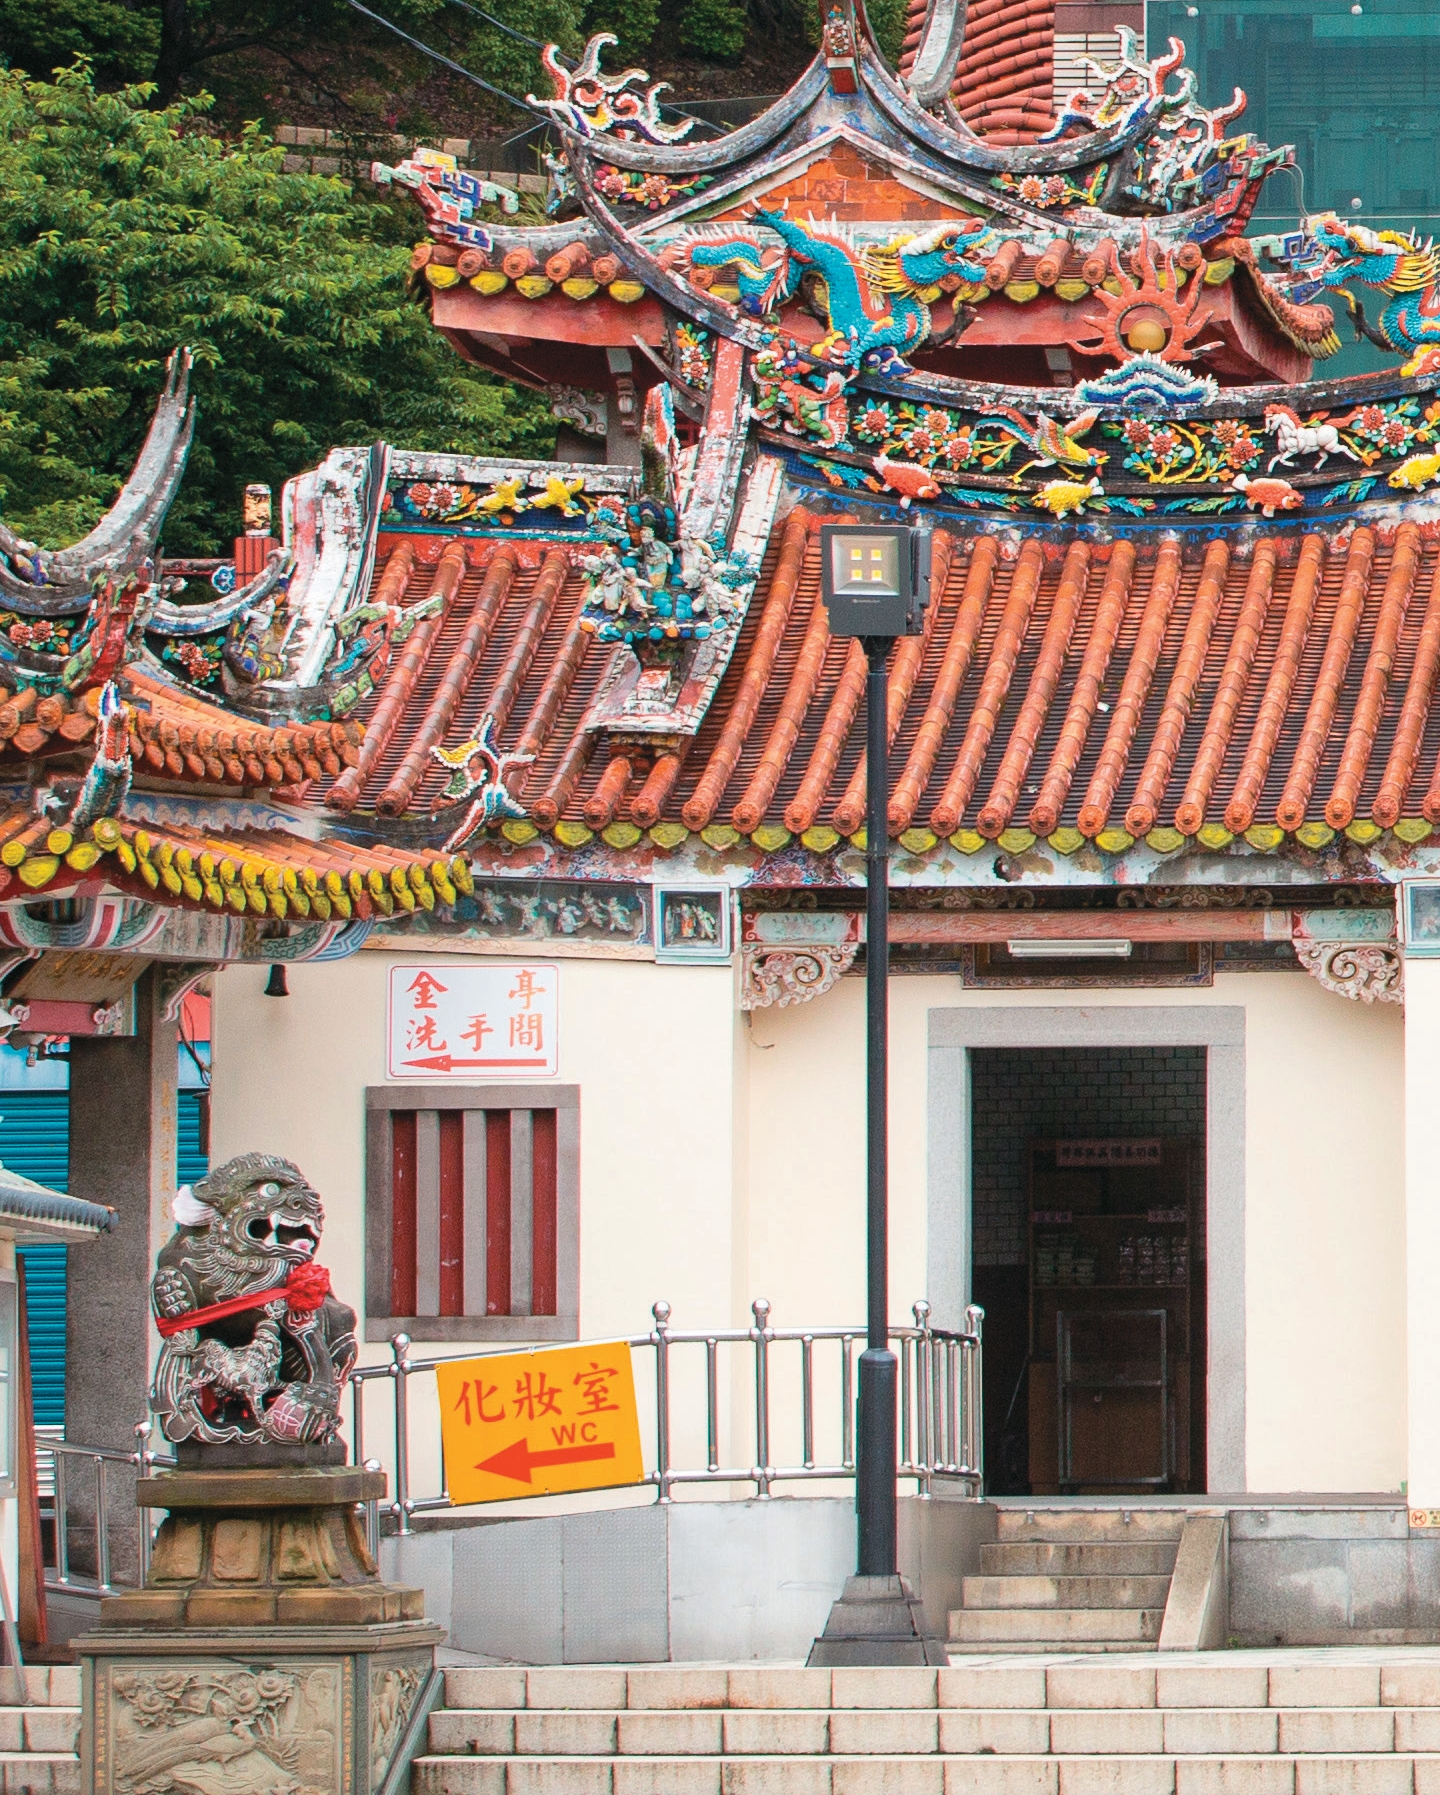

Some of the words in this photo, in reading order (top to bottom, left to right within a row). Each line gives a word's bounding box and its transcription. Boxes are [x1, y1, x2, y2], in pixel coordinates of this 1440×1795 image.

[406, 1013, 544, 1053] 洗手間
[453, 1362, 621, 1427] 化妝室
[551, 1422, 599, 1446] WC
